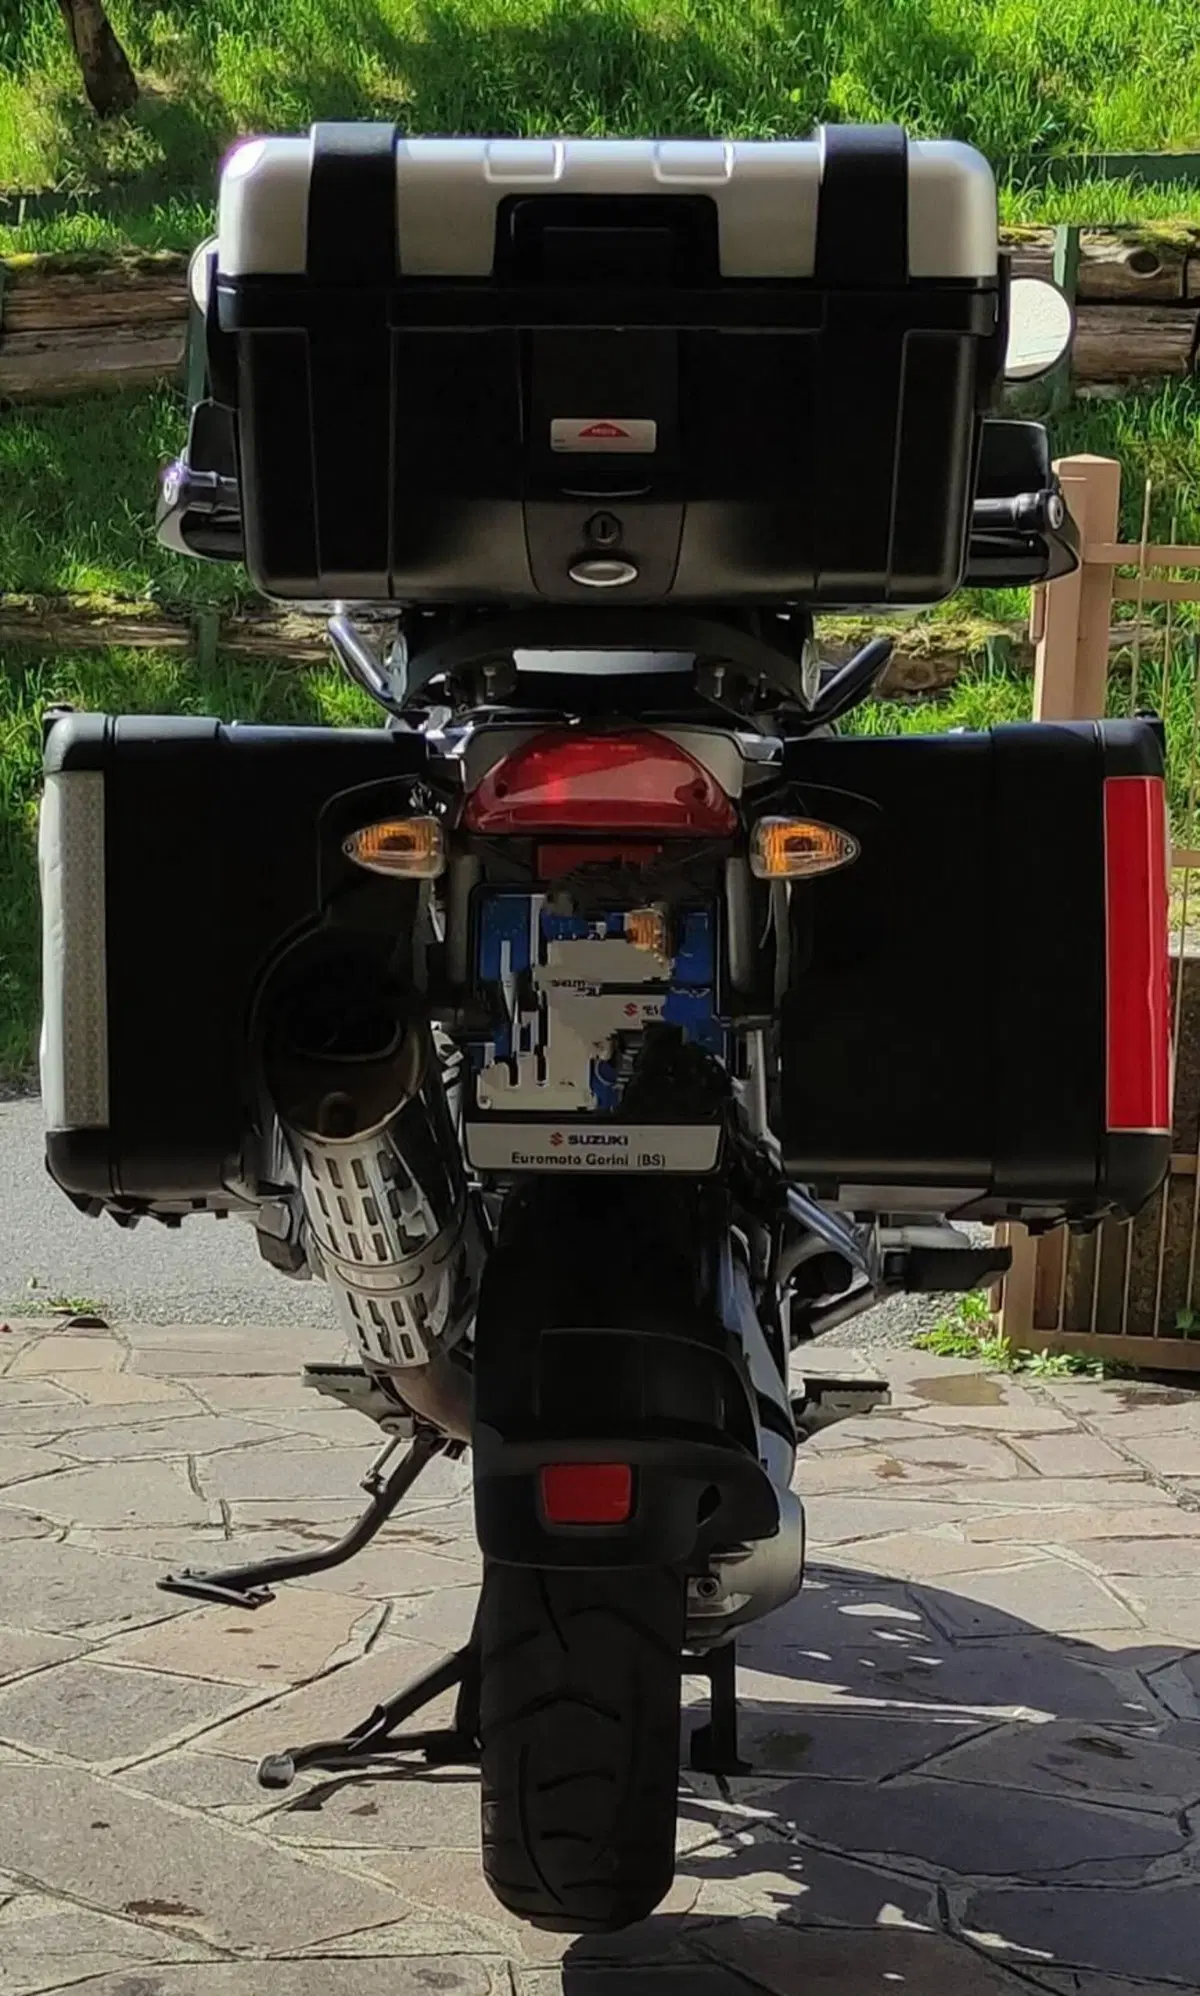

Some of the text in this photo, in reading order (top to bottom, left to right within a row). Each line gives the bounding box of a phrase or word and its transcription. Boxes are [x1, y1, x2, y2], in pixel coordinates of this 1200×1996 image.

[567, 1134, 629, 1146] SUZUKI
[511, 1151, 666, 1167] Euromoto Gorini (BS)
